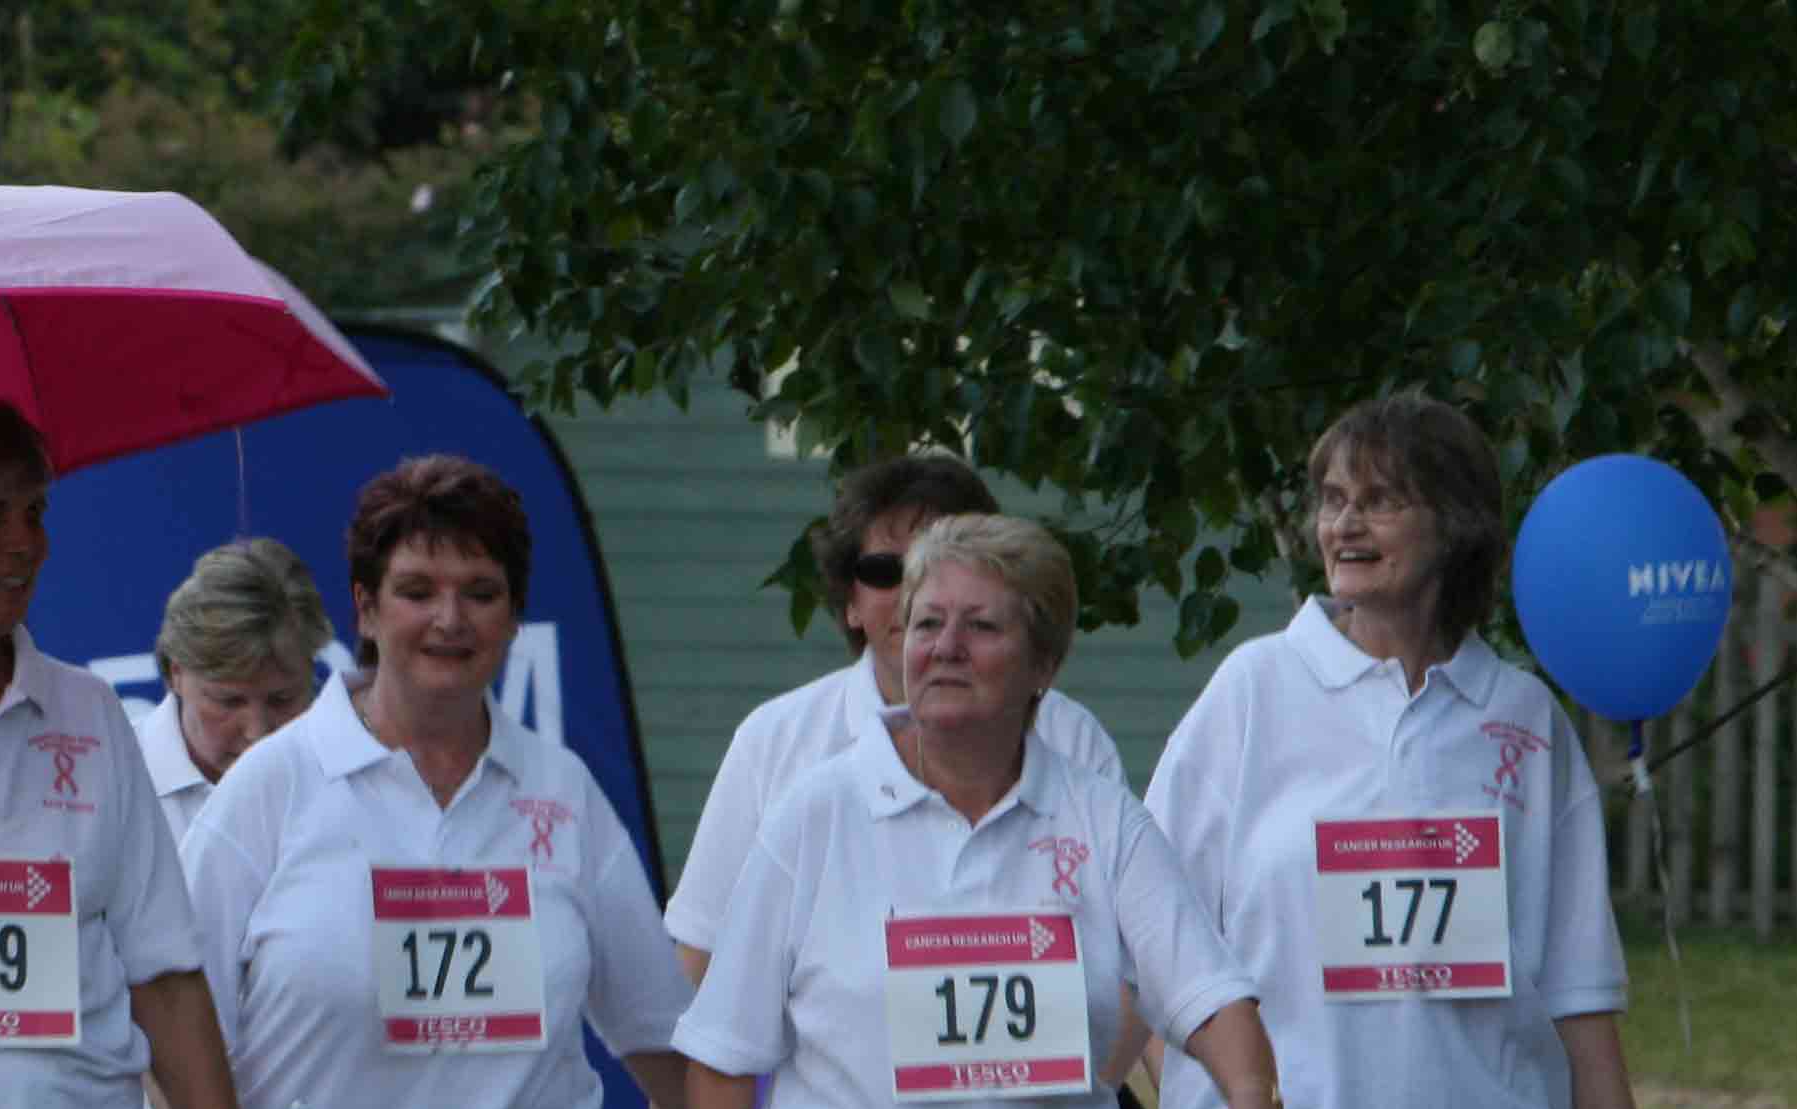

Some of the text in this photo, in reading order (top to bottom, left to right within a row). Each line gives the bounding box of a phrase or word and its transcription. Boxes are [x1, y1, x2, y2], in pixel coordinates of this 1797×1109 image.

[1628, 562, 1724, 595] NIVEA
[1334, 840, 1378, 852] CANCER
[1380, 837, 1436, 850] RESEARCH
[1361, 879, 1457, 946] 177
[905, 932, 1029, 949] CANCER RESEARCH UK
[402, 929, 494, 1000] 172
[1378, 966, 1452, 984] TESCO
[935, 974, 1037, 1045] 179
[953, 1063, 1030, 1083] TESCO
